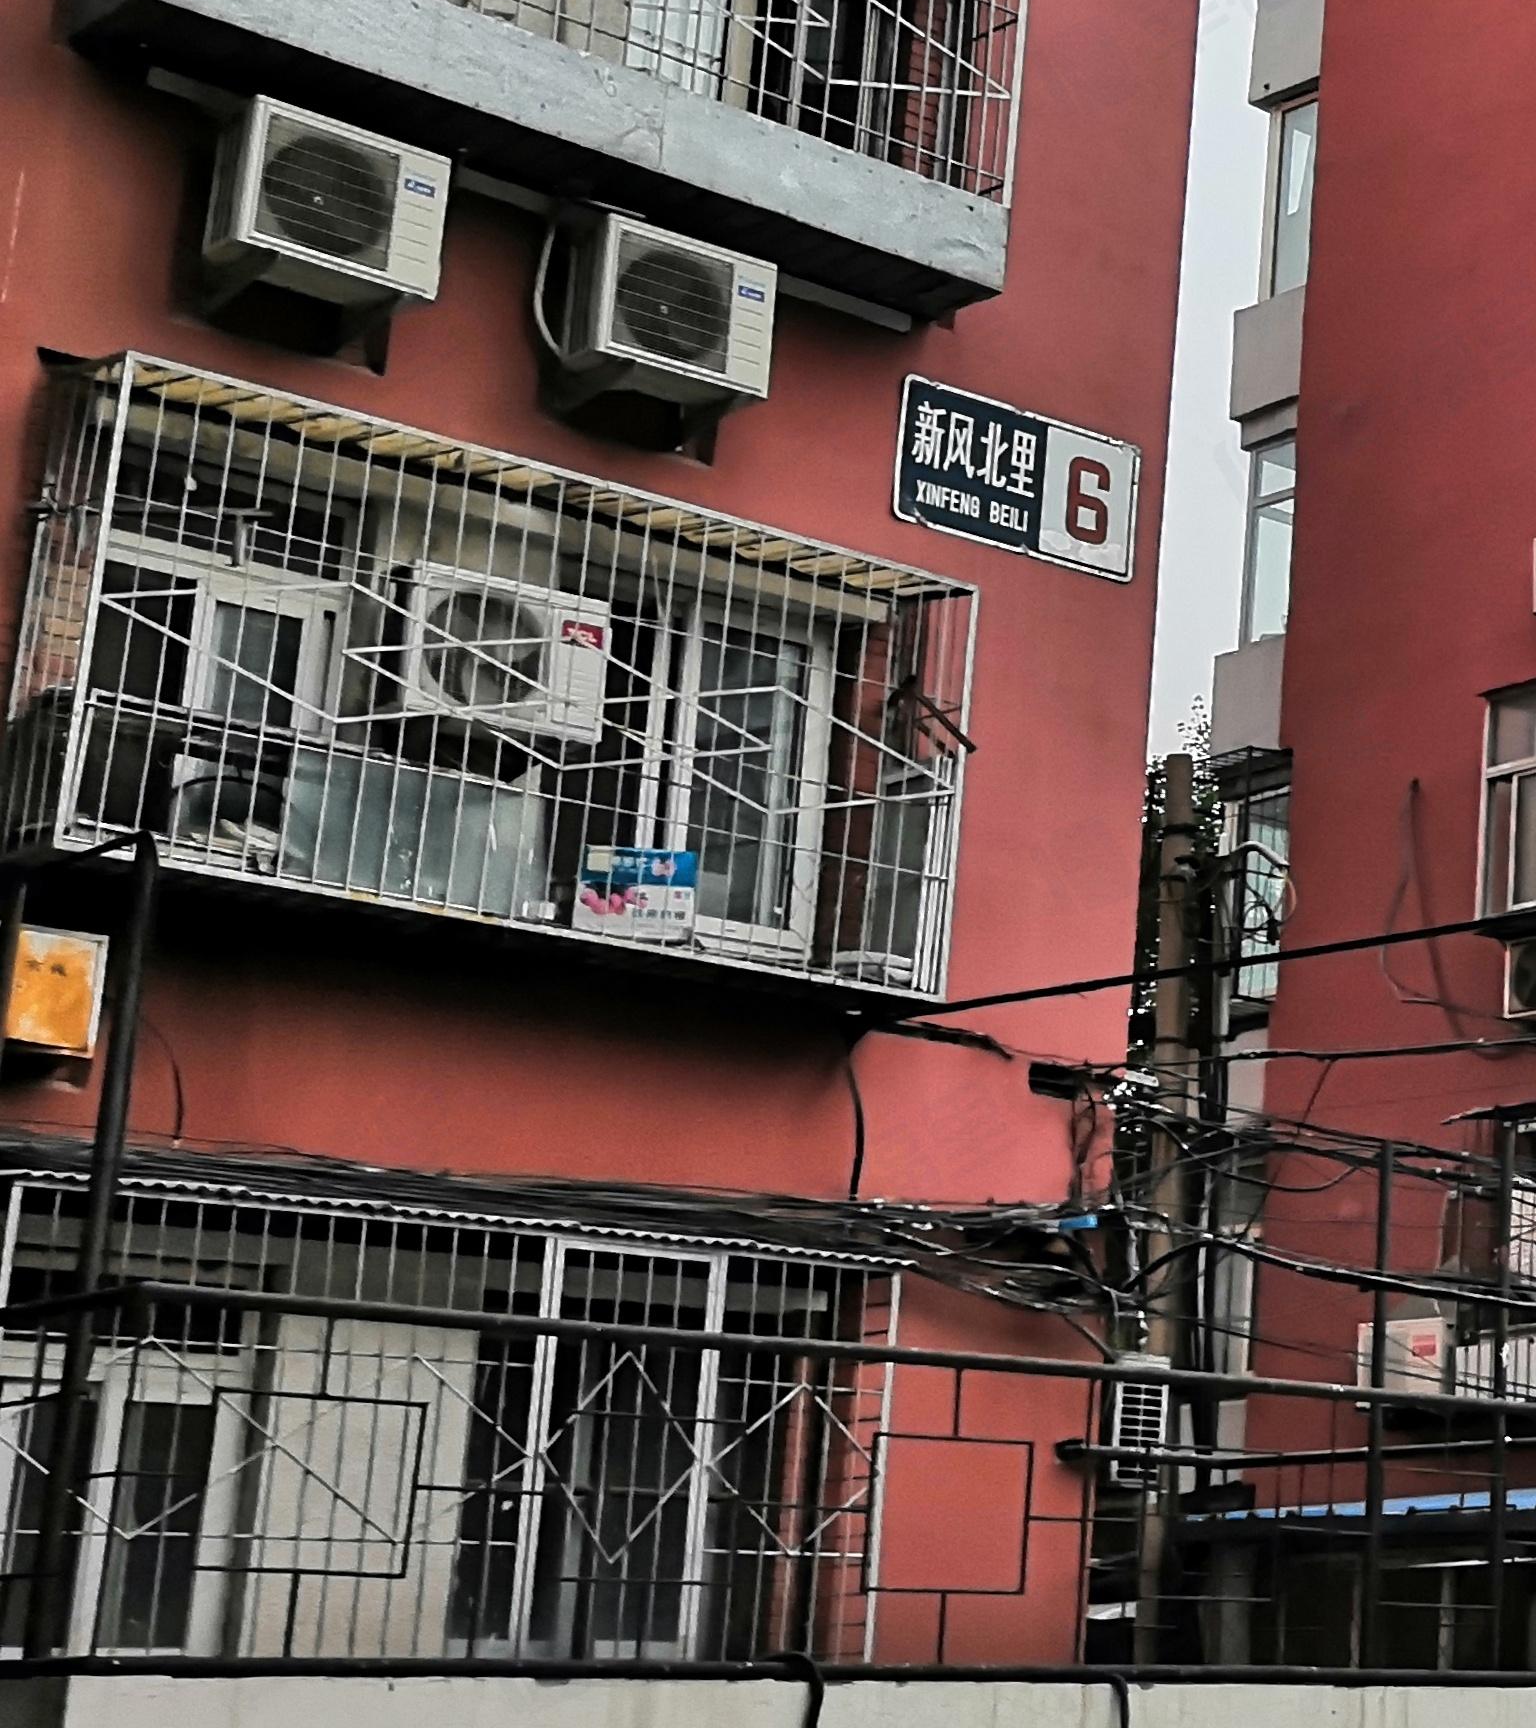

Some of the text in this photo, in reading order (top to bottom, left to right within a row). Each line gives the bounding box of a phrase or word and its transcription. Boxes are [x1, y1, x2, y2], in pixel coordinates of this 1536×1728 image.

[911, 400, 1111, 545] 新风北里 6
[915, 479, 1029, 533] XINFENG BEILI
